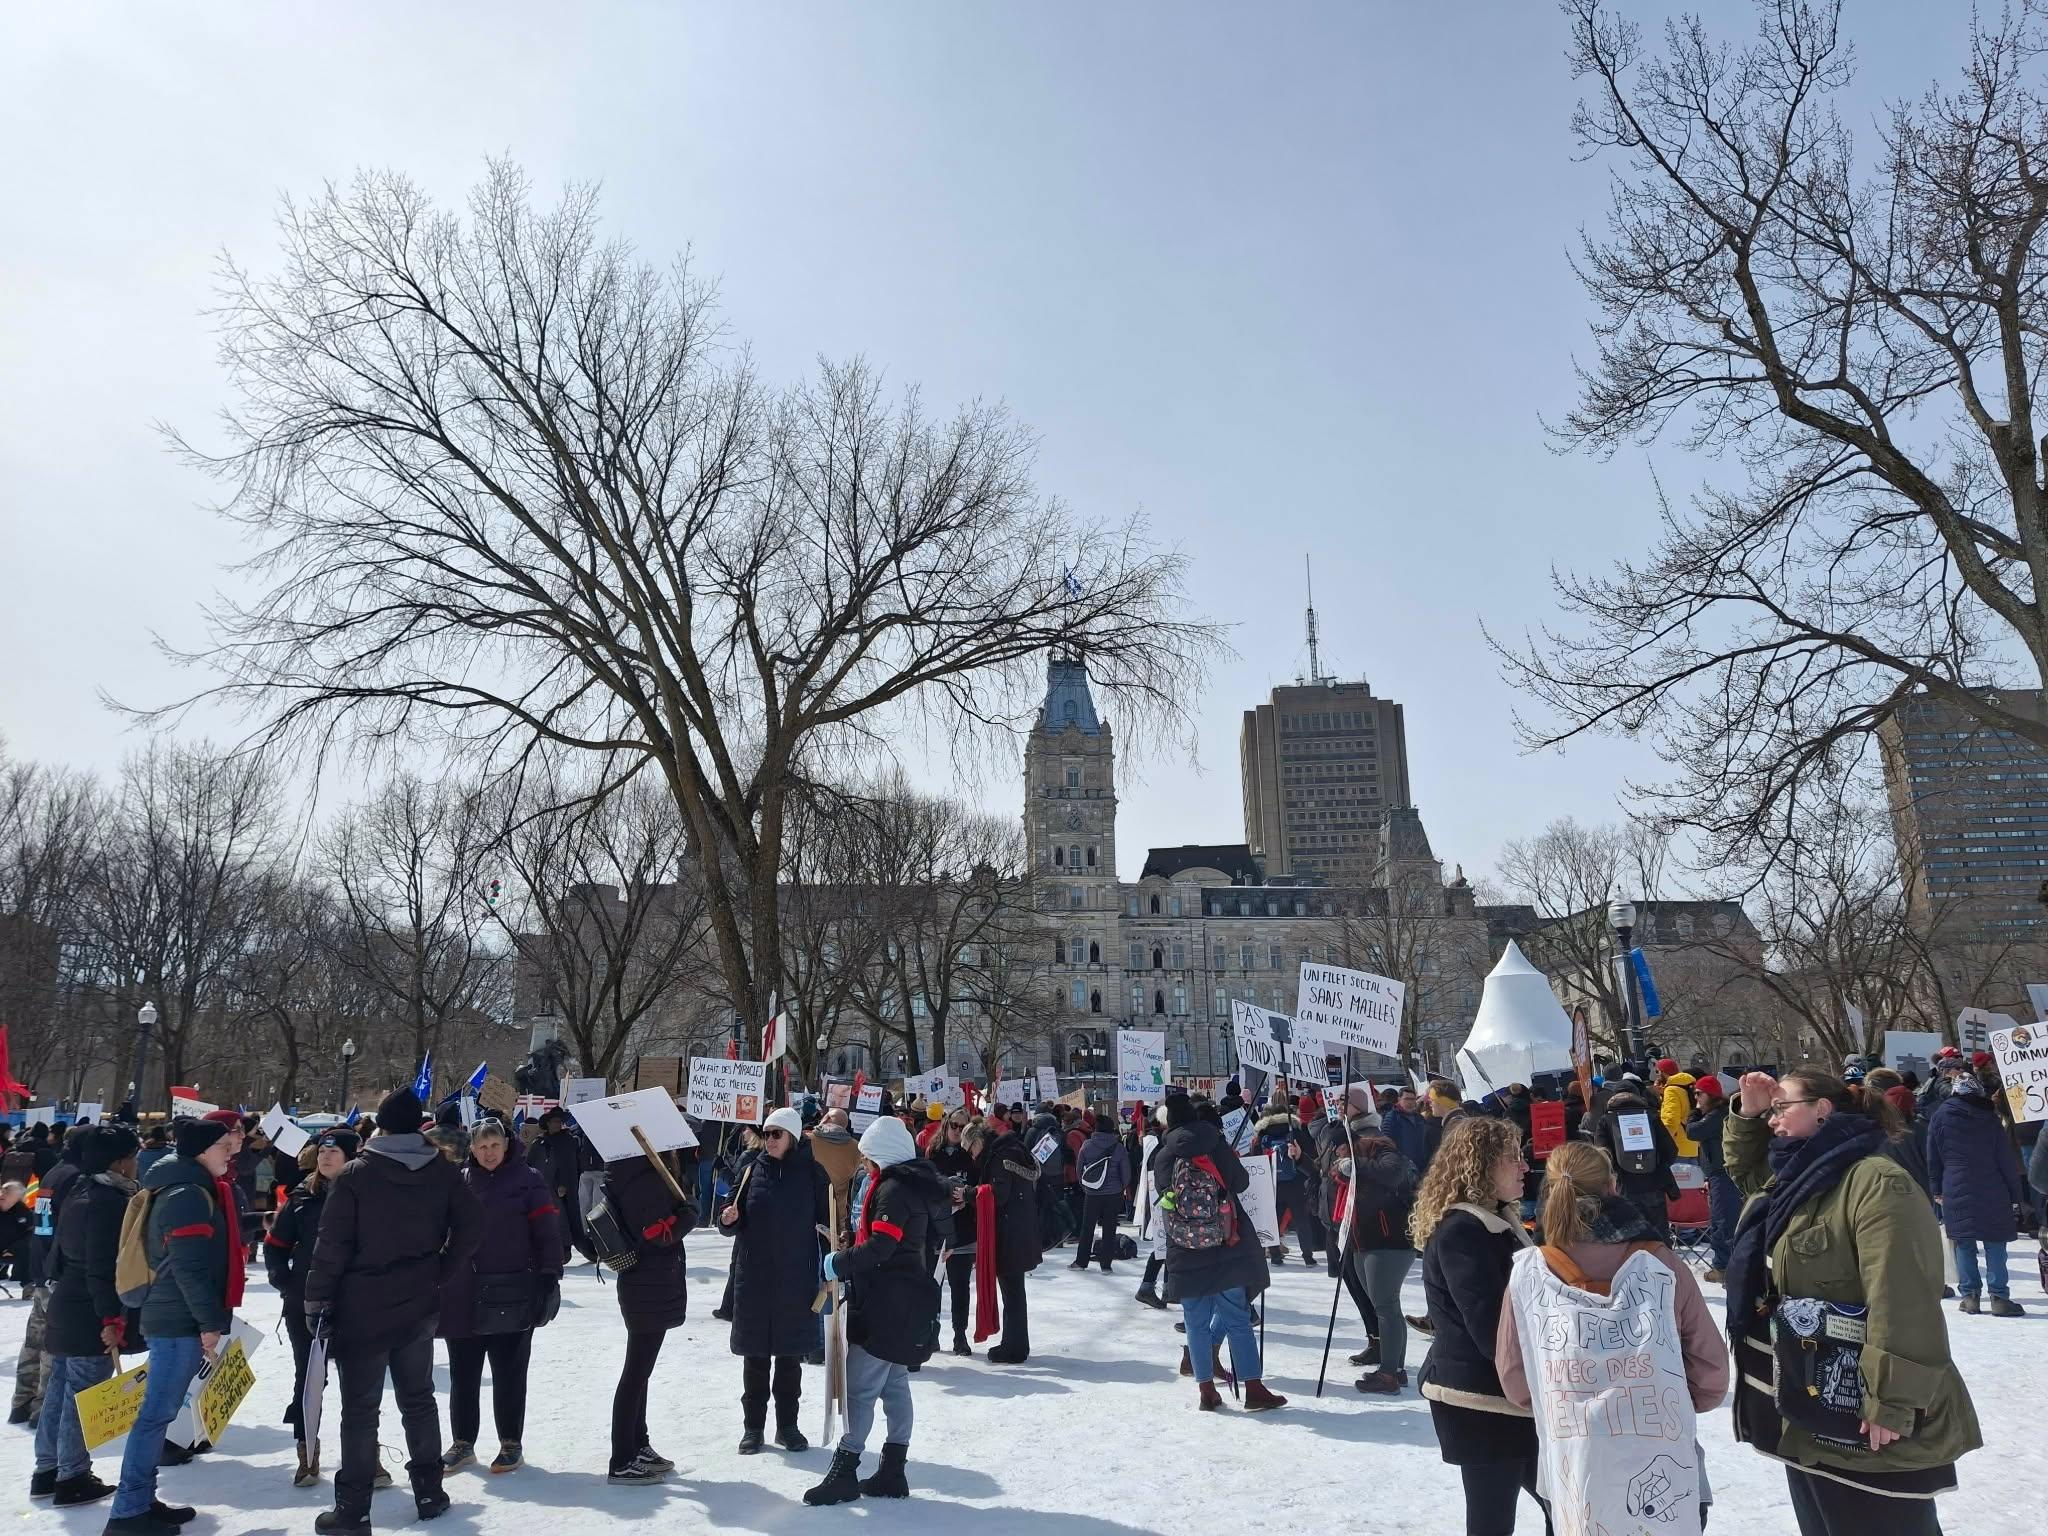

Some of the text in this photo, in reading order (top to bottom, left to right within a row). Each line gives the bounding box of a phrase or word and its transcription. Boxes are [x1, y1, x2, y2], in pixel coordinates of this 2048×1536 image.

[1303, 968, 1381, 994] UN FILET SOCIAL
[1308, 986, 1343, 1010] SANS
[1234, 1000, 1265, 1028] PAS
[1316, 1012, 1330, 1024] NE
[1243, 1025, 1257, 1037] DE
[706, 1063, 720, 1073] FAIT
[721, 1064, 732, 1074] DES
[1292, 1050, 1329, 1082] ACTION
[692, 1074, 757, 1092] AVEC DES MIETTES
[2005, 1071, 2025, 1087] EST
[716, 1092, 731, 1103] AVEC
[693, 1101, 732, 1118] DU PAIN
[1578, 1308, 1675, 1353] FEUX
[1606, 1354, 1654, 1382] DES
